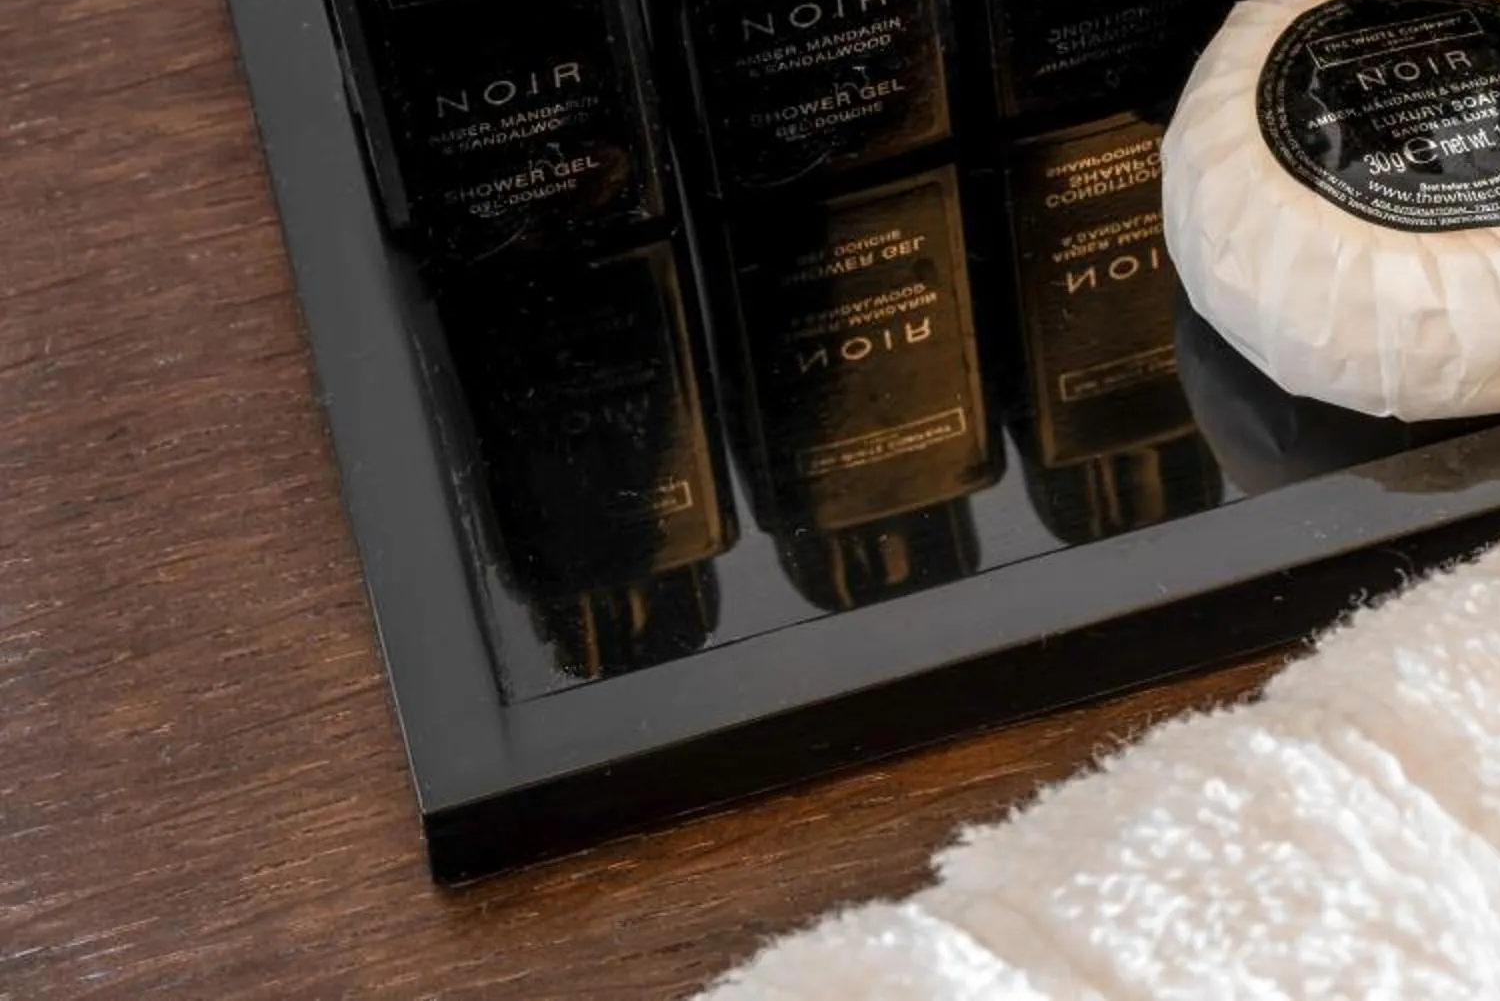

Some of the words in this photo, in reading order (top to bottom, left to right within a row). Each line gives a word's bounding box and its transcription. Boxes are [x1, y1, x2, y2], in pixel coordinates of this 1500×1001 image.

[805, 15, 902, 51] MANDARIN
[766, 33, 892, 75] SANDALWOOD
[1356, 49, 1473, 92] NOIR
[435, 61, 581, 119] NOIR
[859, 78, 906, 101] GEL
[1371, 101, 1445, 131] LUXURY
[1451, 89, 1500, 112] SOAP
[1462, 106, 1500, 123] LUXE
[1440, 132, 1470, 156] net
[553, 155, 600, 179] GEL
